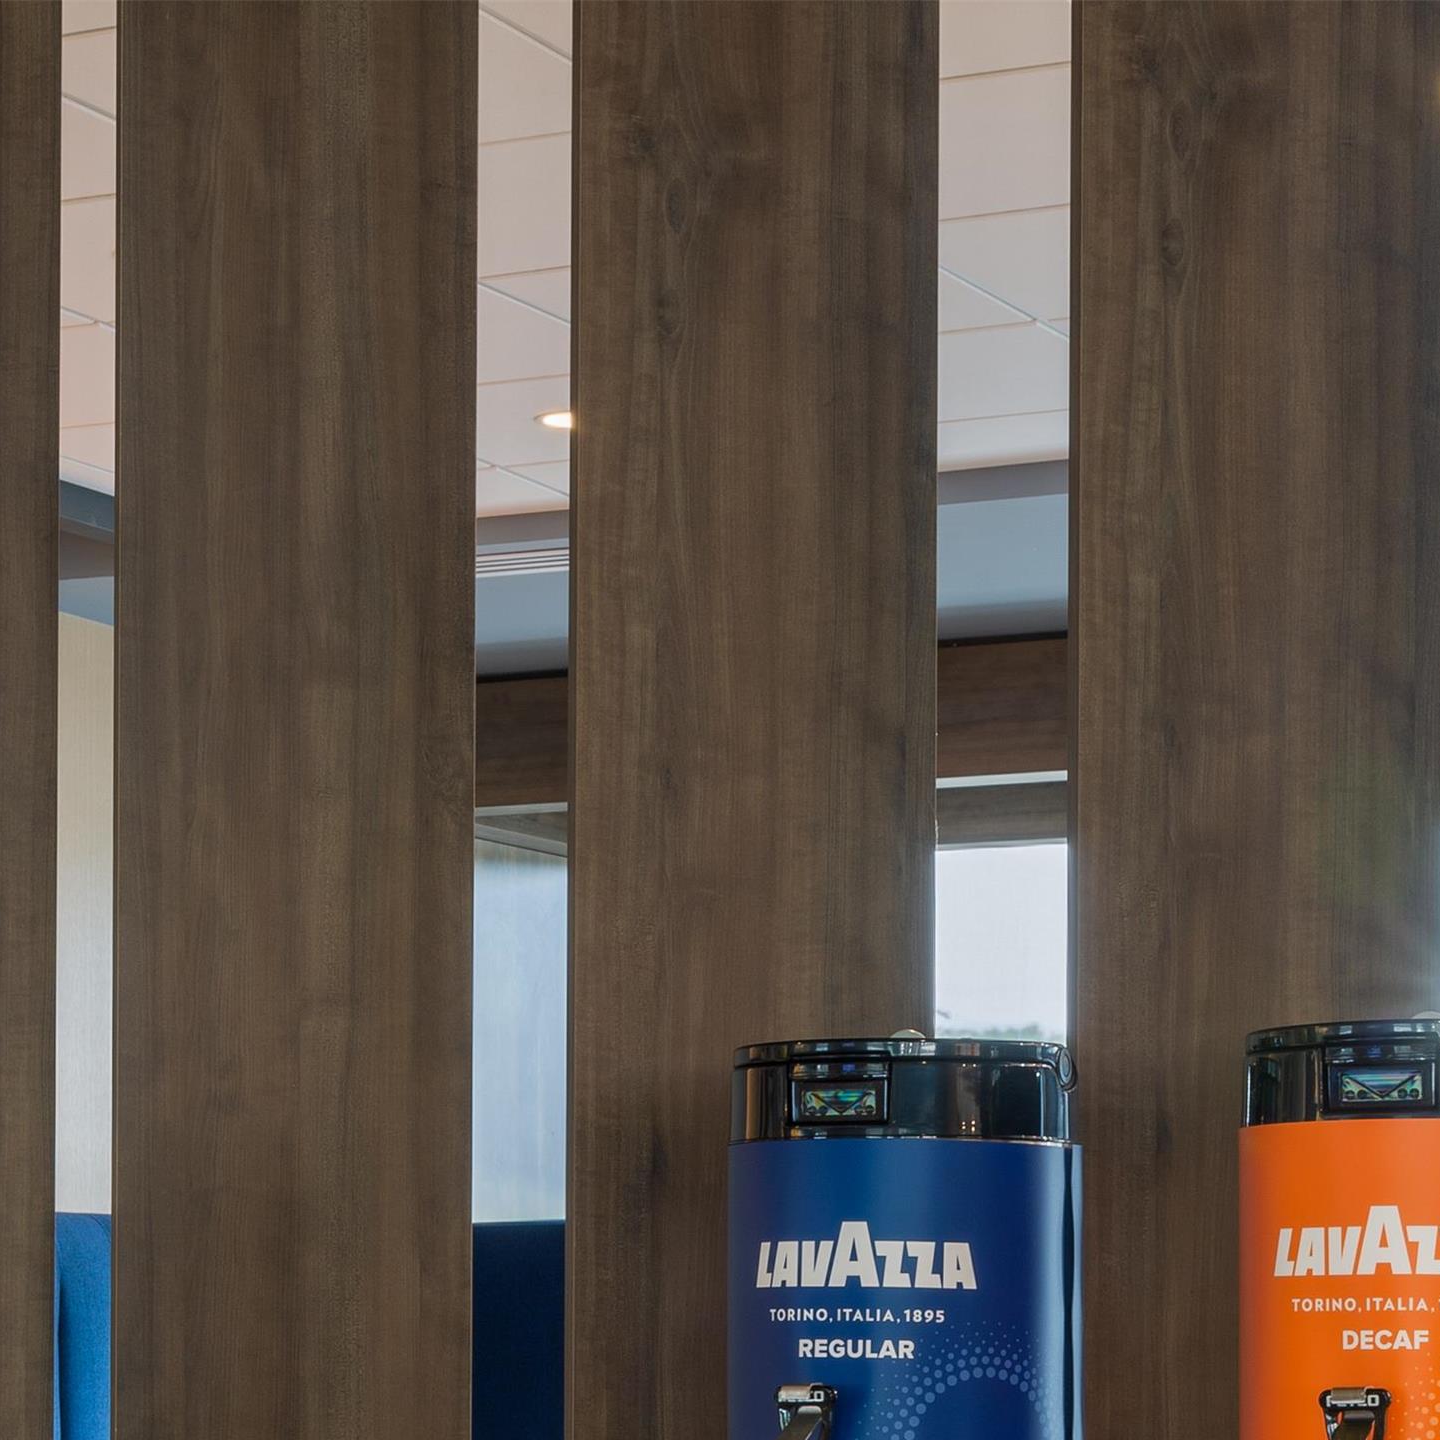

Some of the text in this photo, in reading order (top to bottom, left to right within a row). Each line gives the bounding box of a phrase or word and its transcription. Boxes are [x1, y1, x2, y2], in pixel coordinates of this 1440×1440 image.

[756, 1220, 978, 1290] LAVAZZA
[769, 1307, 946, 1324] TORINO, ITALIA, 1895
[1291, 1297, 1362, 1313] TORINO,
[1365, 1296, 1436, 1313] ITALIA,
[798, 1338, 915, 1360] REGULAR
[1342, 1329, 1430, 1351] DECAF
